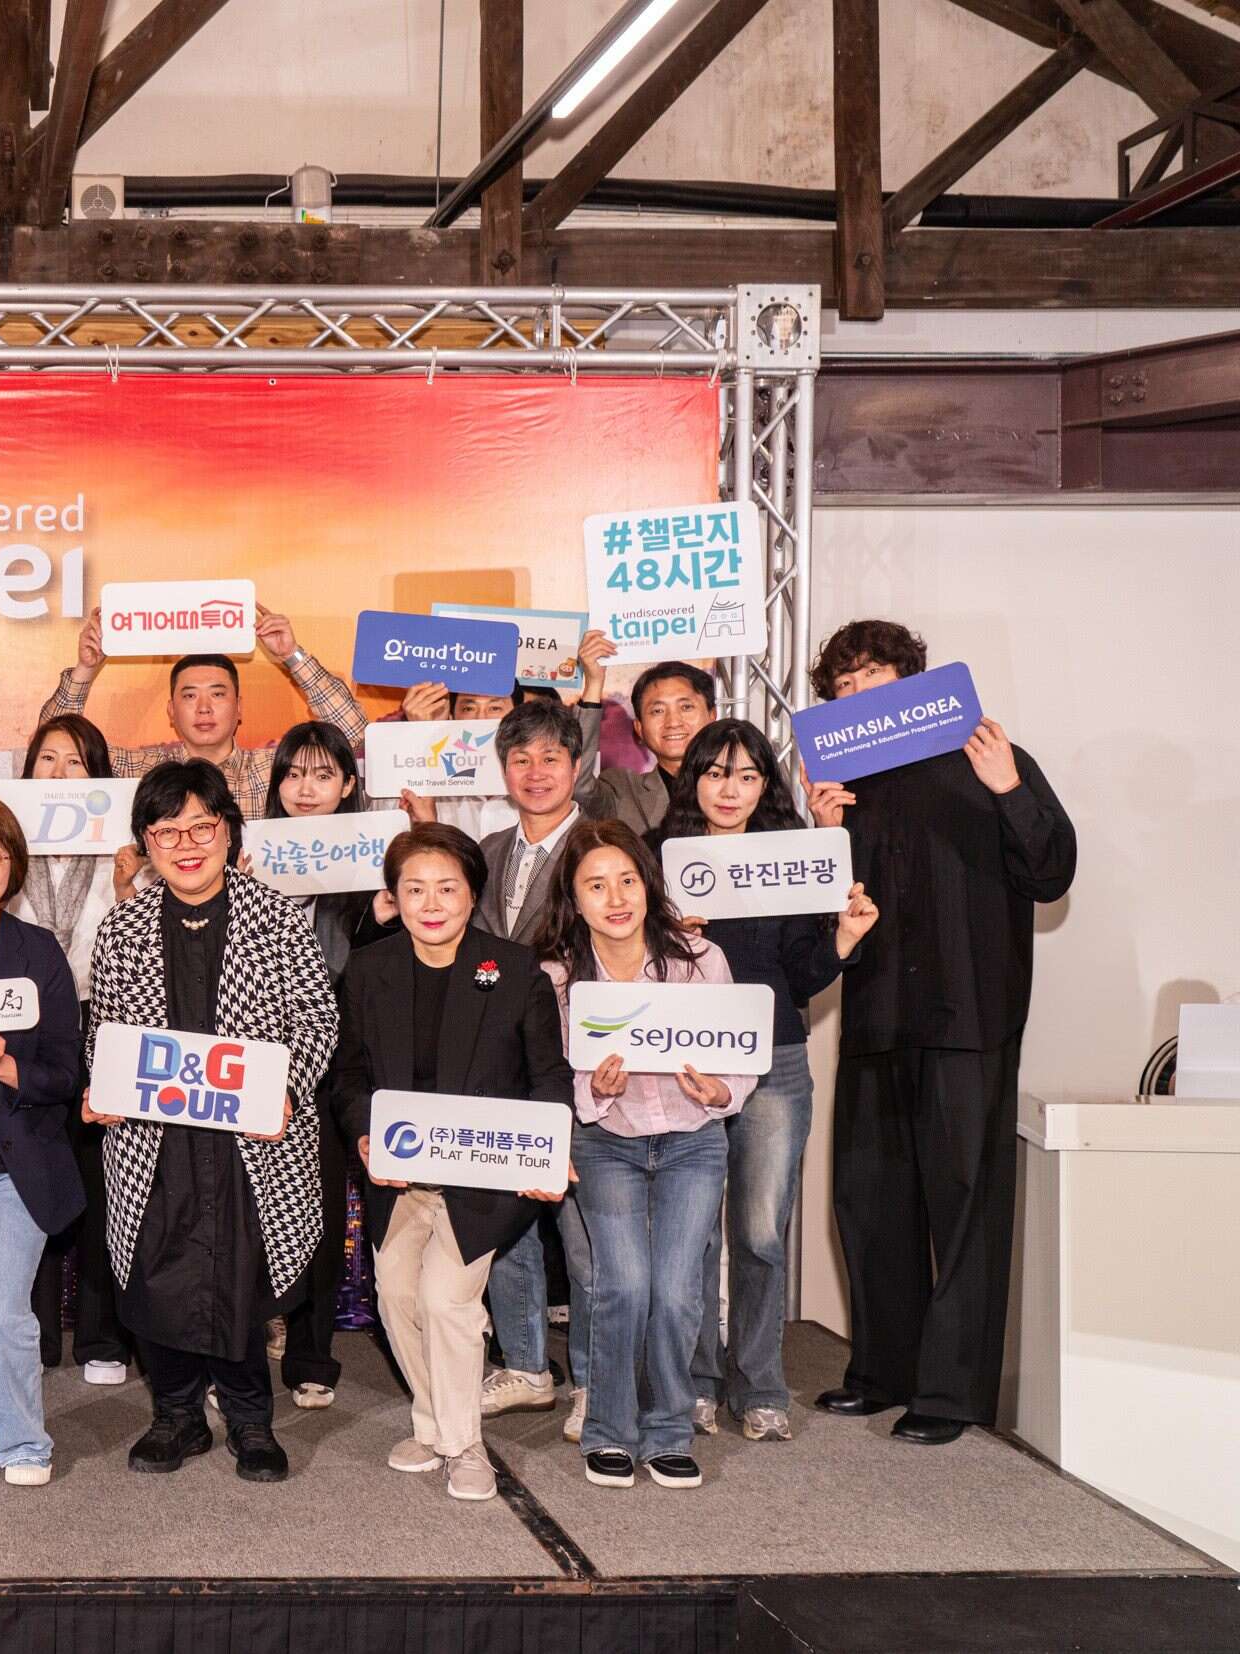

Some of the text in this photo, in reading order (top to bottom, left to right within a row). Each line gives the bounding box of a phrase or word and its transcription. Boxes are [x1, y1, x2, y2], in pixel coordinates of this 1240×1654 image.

[603, 511, 740, 556] #챌린지
[606, 548, 743, 593] 48시간
[622, 604, 695, 620] undiscovered
[609, 613, 696, 645] taipei
[383, 638, 497, 664] grand tour
[419, 661, 469, 673] Group
[814, 695, 962, 751] FUNTASIA KOREA
[393, 736, 449, 768] Lead
[820, 750, 843, 761] Culture
[426, 779, 446, 787] Travel
[261, 833, 385, 875] 참좋은여행
[727, 858, 837, 889] 한진관광
[137, 1033, 245, 1091] D&G
[135, 1082, 240, 1124] TOUR
[429, 1127, 553, 1153] (주)플래폼투어
[430, 1146, 550, 1168] PLAT FORM TOUR
